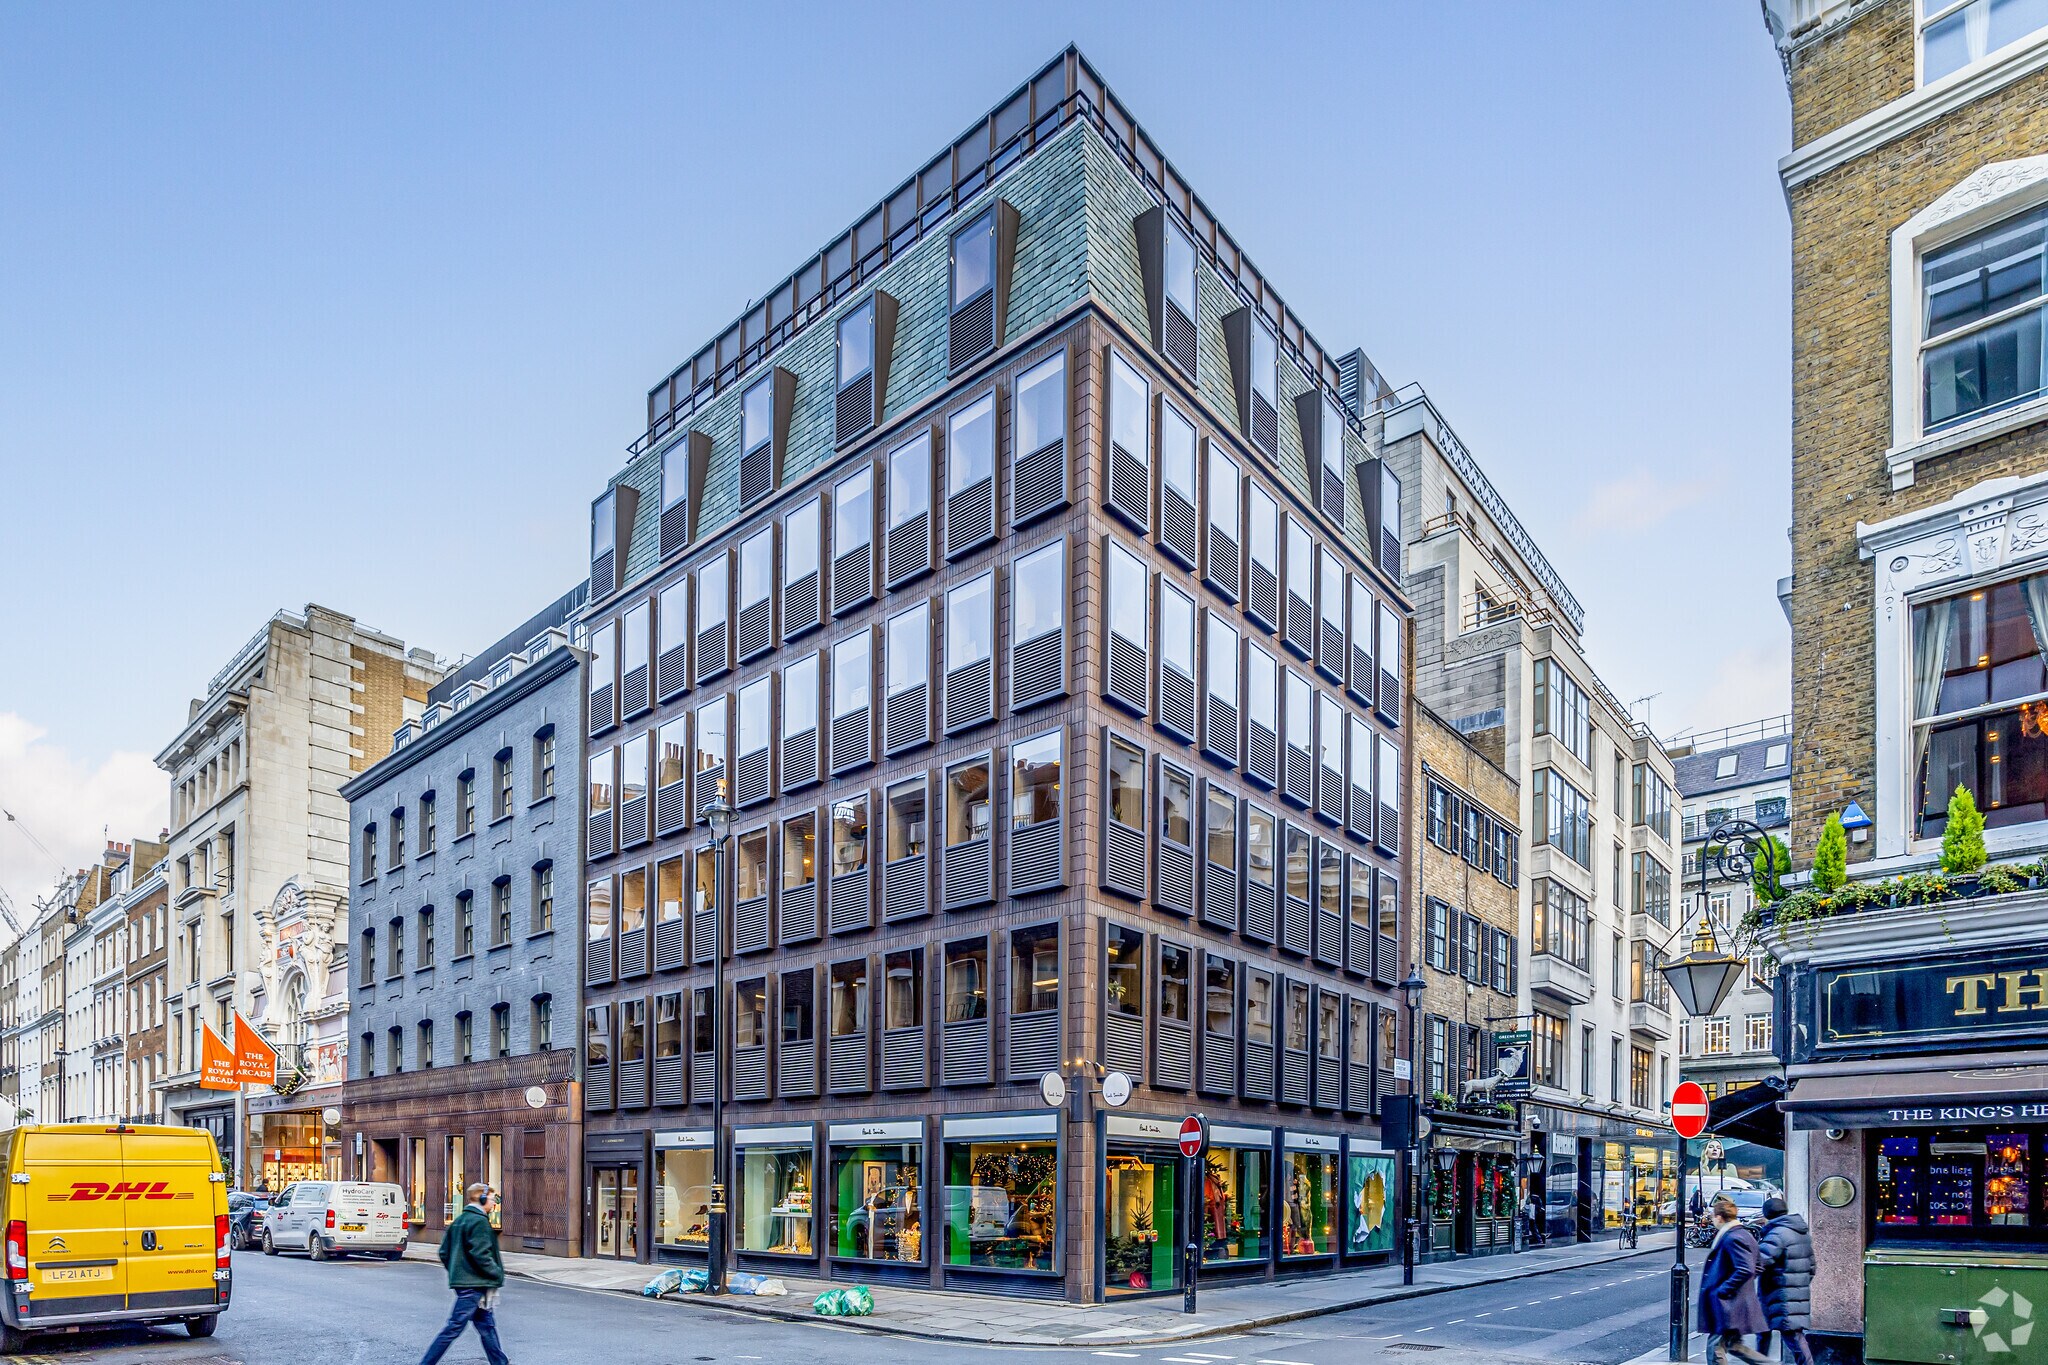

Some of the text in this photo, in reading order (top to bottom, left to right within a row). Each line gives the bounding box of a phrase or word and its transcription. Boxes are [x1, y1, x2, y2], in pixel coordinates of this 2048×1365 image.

[1946, 968, 2048, 1016] TH
[245, 1052, 264, 1060] THE
[212, 1060, 231, 1068] THE
[239, 1060, 270, 1069] ROYAL
[236, 1068, 272, 1078] ARCADE
[204, 1075, 239, 1084] ARCAD
[1888, 1109, 1933, 1121] THE
[1939, 1105, 2014, 1120] KING'S
[69, 1182, 176, 1201] DHL
[52, 1269, 101, 1280] LF21 ATJ
